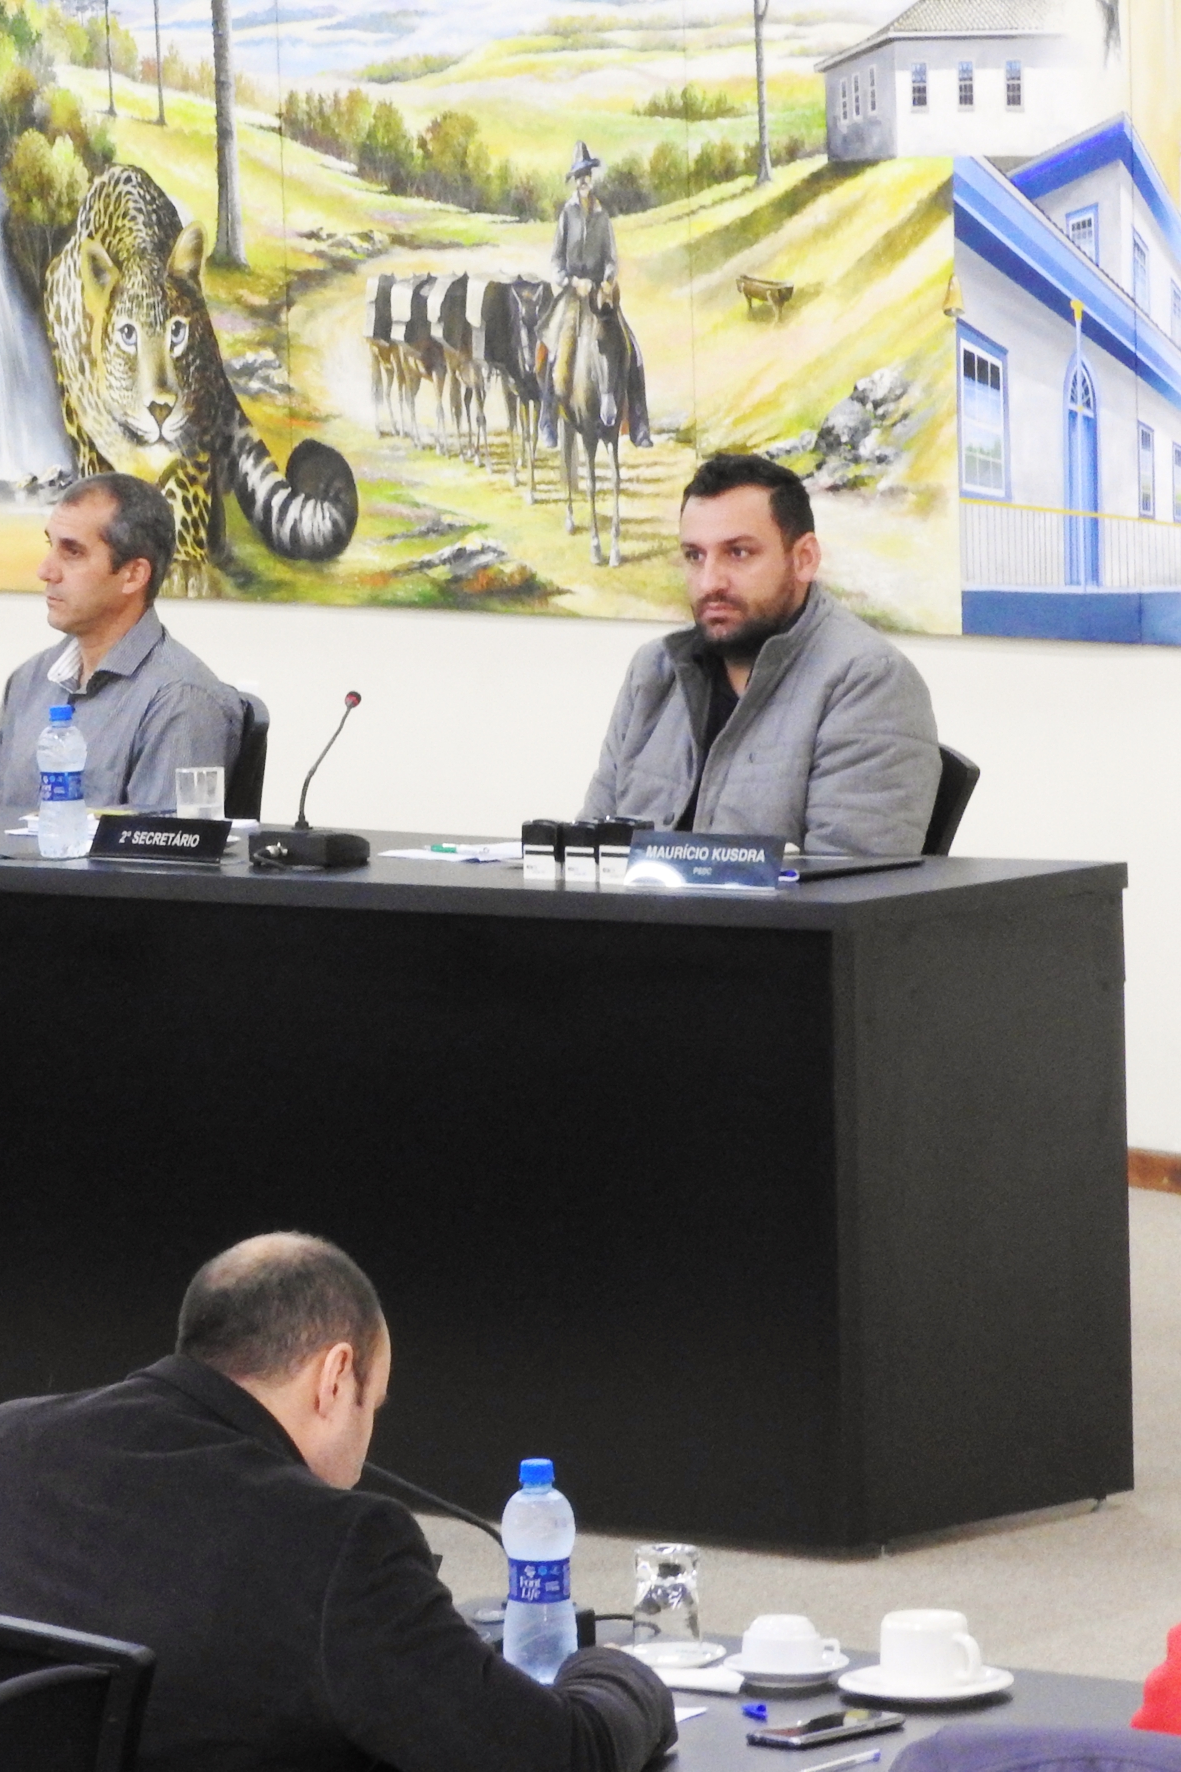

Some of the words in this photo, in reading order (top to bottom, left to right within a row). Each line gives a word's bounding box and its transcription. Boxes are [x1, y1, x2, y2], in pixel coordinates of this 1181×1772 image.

[131, 830, 200, 848] SECRETÁRIO
[645, 843, 709, 861] MAURÍCIO
[711, 847, 766, 863] KUSDRA
